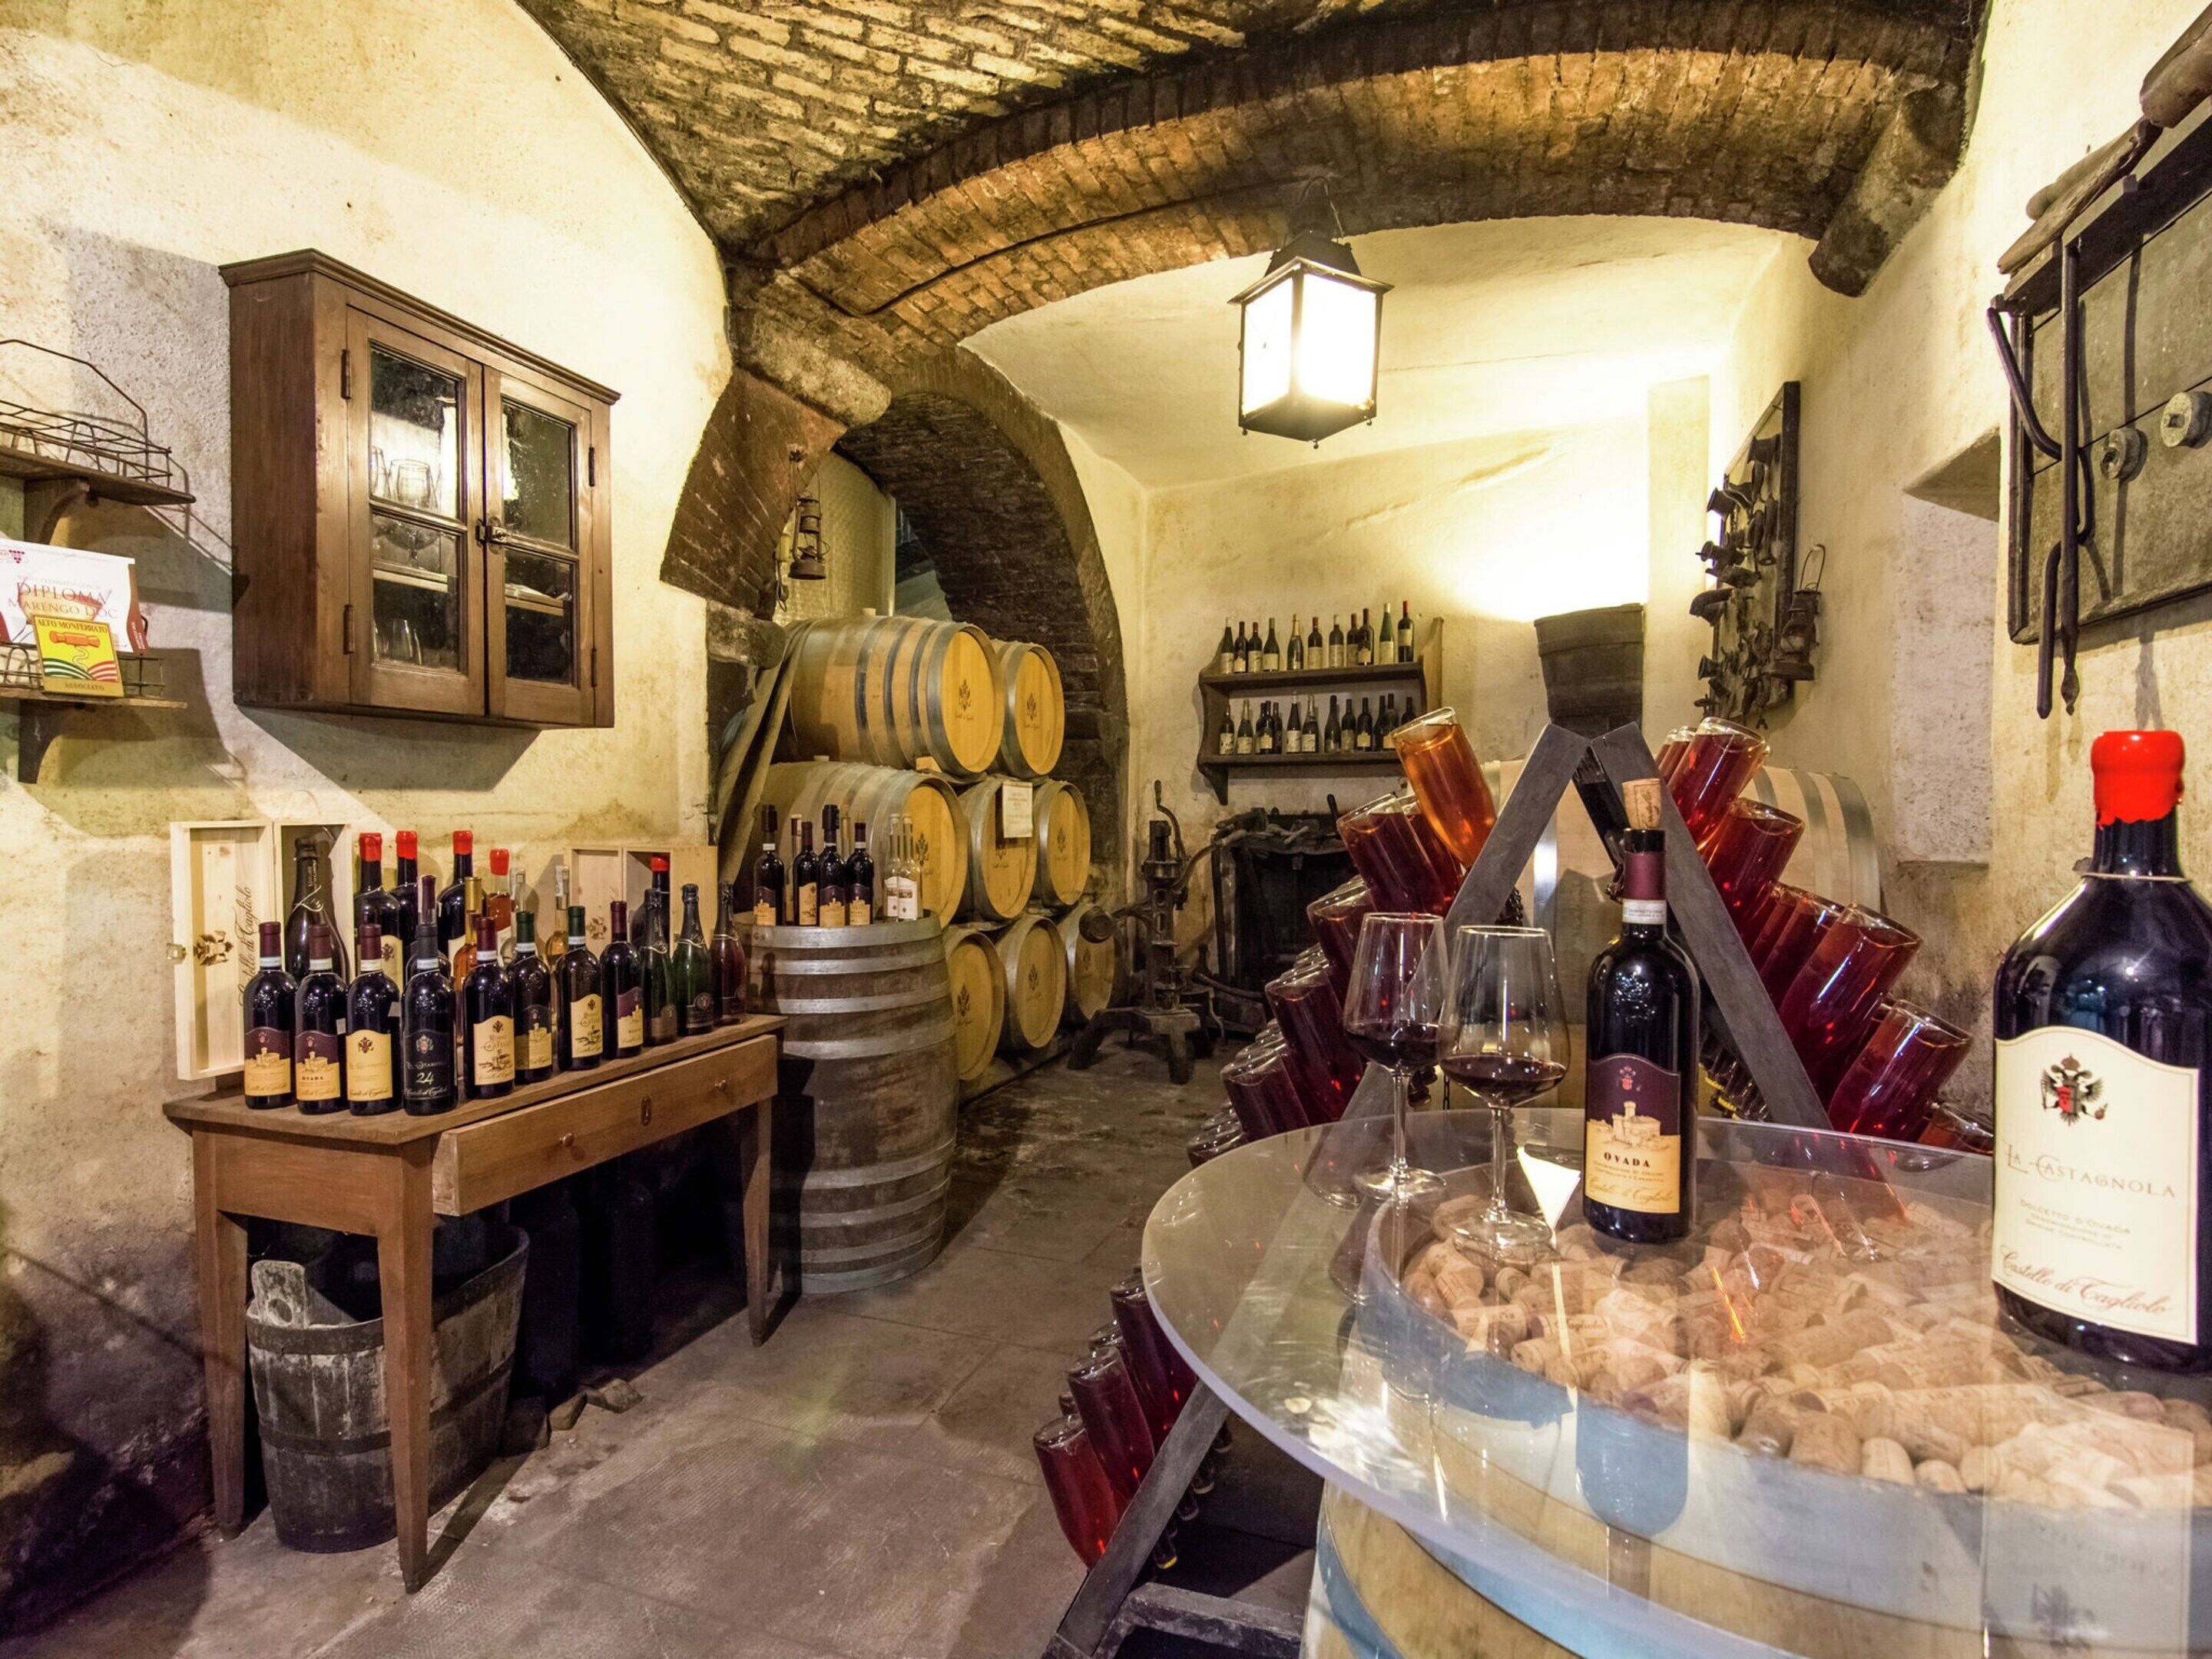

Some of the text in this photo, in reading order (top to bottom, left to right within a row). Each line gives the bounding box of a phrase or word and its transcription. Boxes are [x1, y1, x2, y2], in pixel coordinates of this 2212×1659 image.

[8, 596, 81, 615] MARENGO
[38, 618, 108, 634] ALTO MONFERRATO
[416, 1071, 435, 1084] 24
[1604, 1151, 1651, 1167] OVADA
[1999, 1243, 2173, 1315] Castello di Tagliolo
